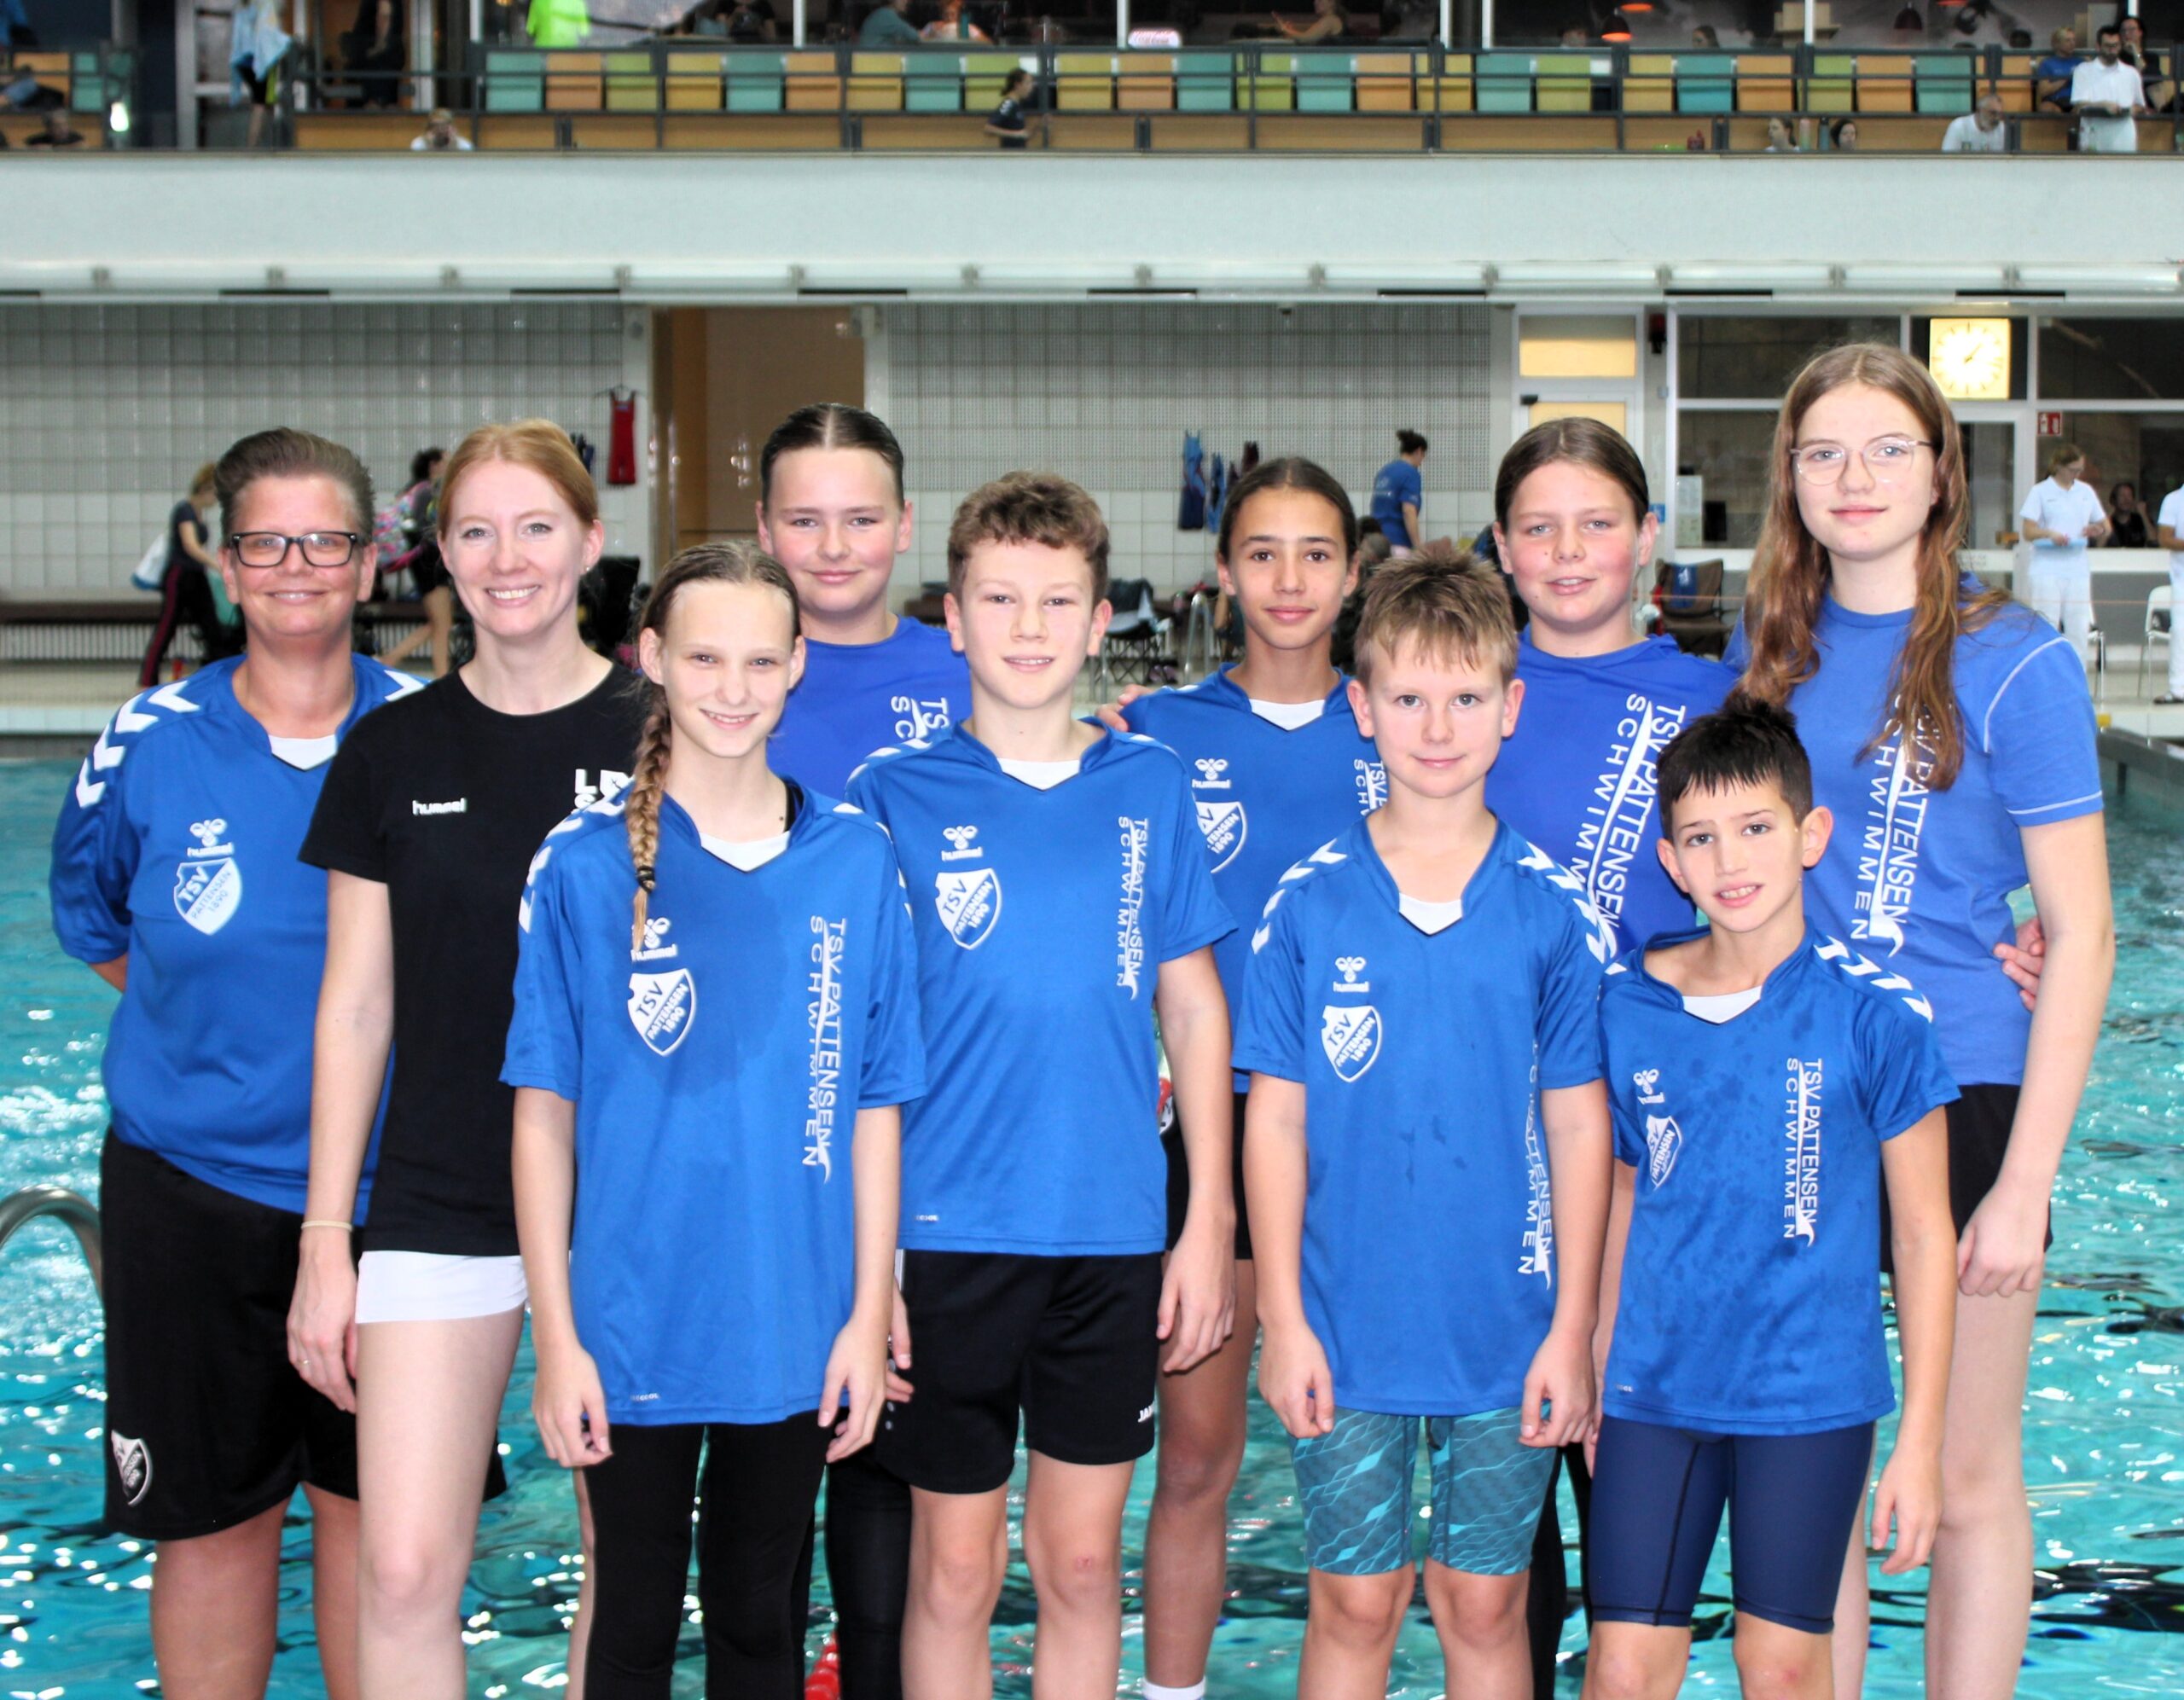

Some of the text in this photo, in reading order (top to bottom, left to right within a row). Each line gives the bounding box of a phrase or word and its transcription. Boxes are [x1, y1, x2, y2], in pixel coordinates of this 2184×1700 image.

[921, 697, 950, 729] TS
[412, 798, 467, 815] hummel
[1569, 693, 1647, 885] SCHWIMM
[1133, 817, 1148, 857] TSV
[1594, 759, 1658, 928] PATTENSEN
[177, 866, 209, 902] TSV
[191, 870, 231, 919] PATTENSEN
[208, 890, 229, 912] 1890
[943, 879, 967, 914] TSV
[1117, 815, 1131, 987] SCHWIMMEN
[636, 981, 663, 1017] TSV
[816, 918, 847, 1148] TSV PATTENSEN
[1327, 1013, 1351, 1046] TSV
[1783, 1057, 1799, 1239] SCHWIMMEN
[1799, 1058, 1822, 1224] TSV PATTENSEN
